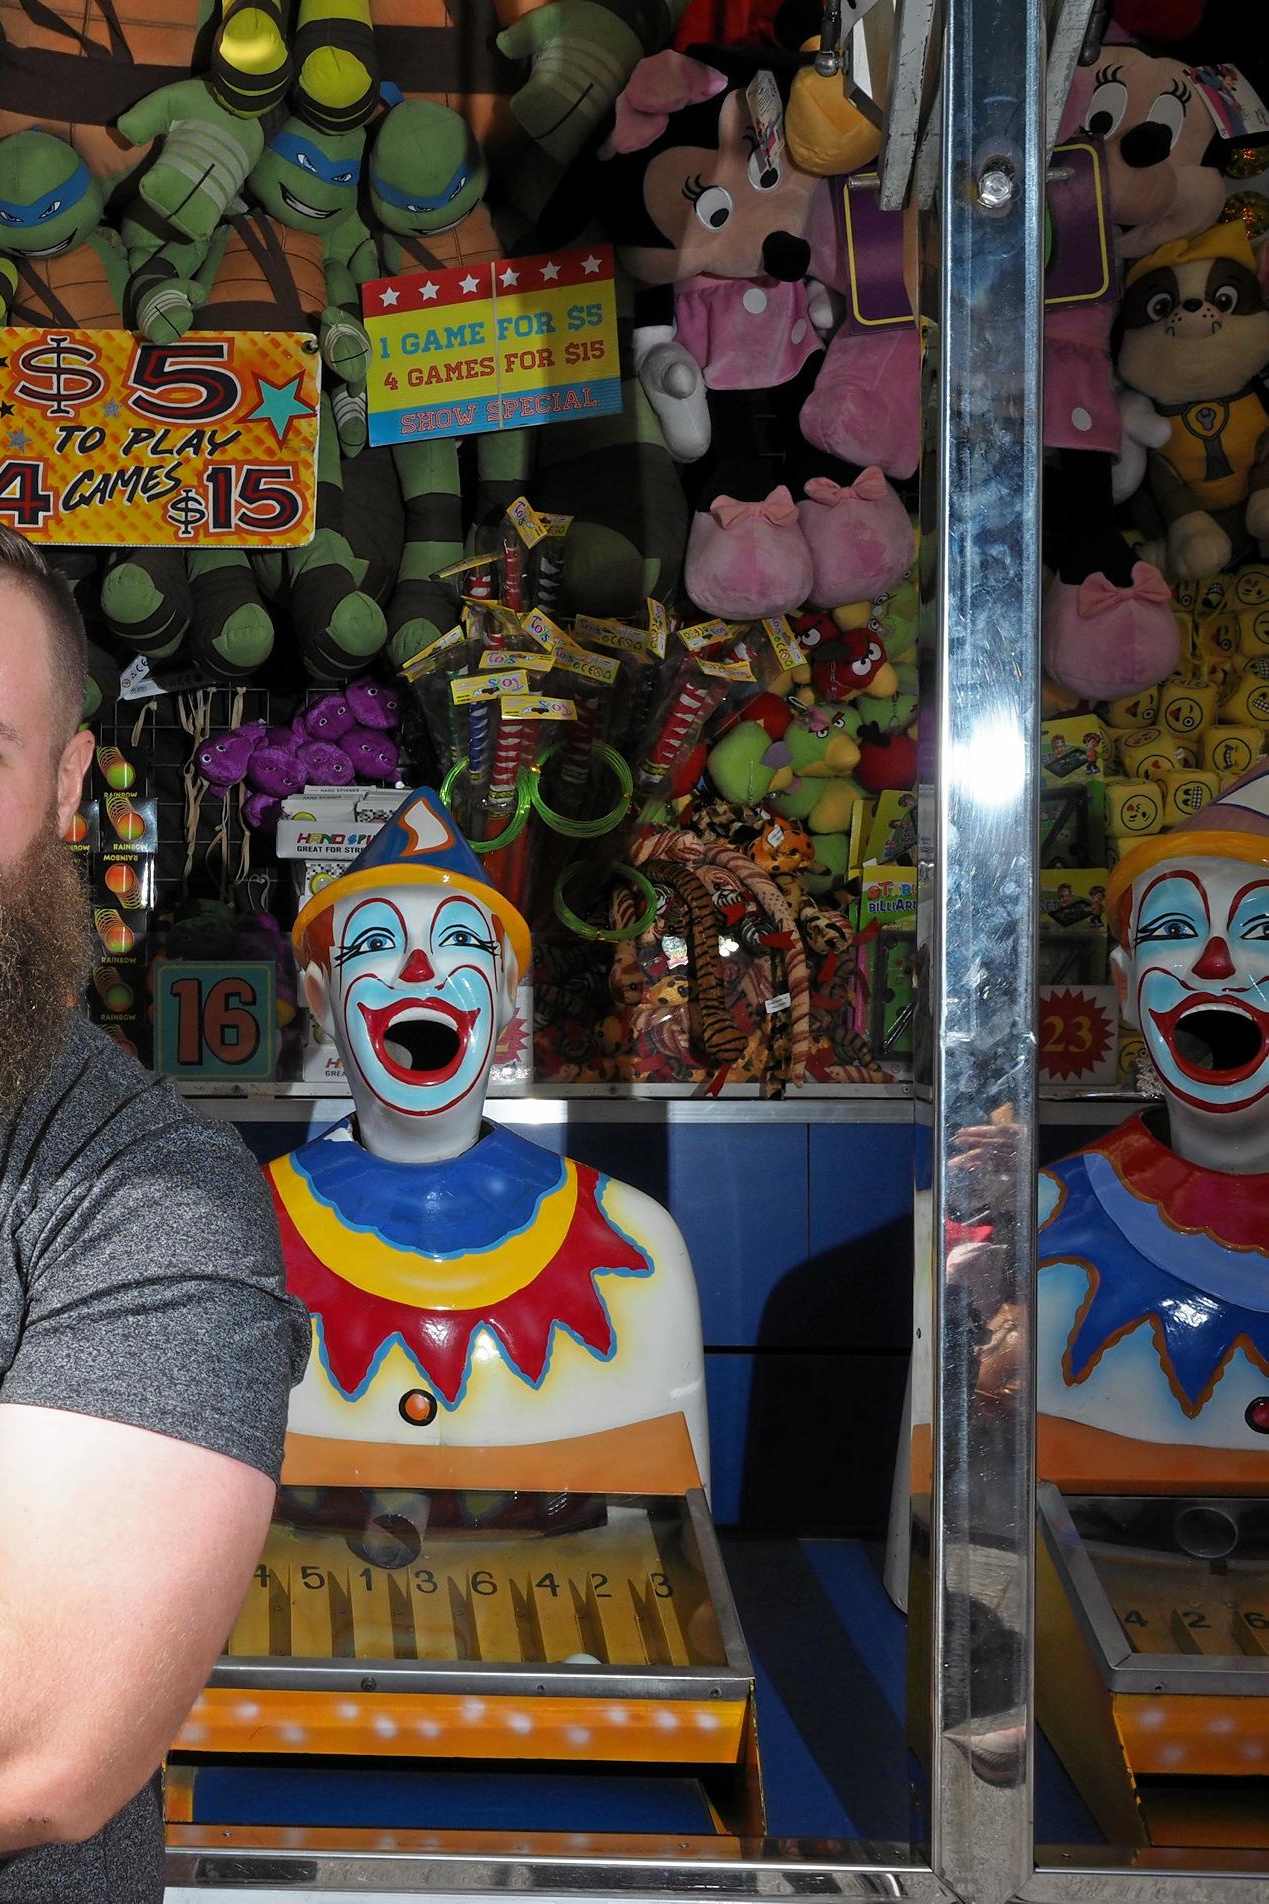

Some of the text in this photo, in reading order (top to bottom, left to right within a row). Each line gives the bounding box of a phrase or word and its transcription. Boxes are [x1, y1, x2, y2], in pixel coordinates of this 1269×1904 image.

[401, 321, 486, 356] GAME
[497, 311, 555, 341] FOR
[567, 304, 603, 332] $5
[383, 340, 605, 390] 4 GAMES FOR $15
[401, 387, 598, 434] SHOW SPECIAL
[54, 425, 243, 459] TO PLAY
[59, 461, 183, 514] GAMES
[167, 464, 303, 538] $15
[103, 854, 139, 862] RAINBOW
[297, 845, 323, 853] GREAT
[101, 956, 137, 964] RAINBOW
[170, 977, 261, 1066] 16
[1041, 1015, 1093, 1052] 23
[301, 1566, 325, 1590] 5
[359, 1568, 373, 1591] 1
[414, 1570, 439, 1594] 3
[470, 1571, 499, 1596] 6
[535, 1573, 560, 1598] 4
[591, 1574, 613, 1598] 2
[653, 1573, 674, 1598] 3
[1124, 1610, 1148, 1628] 4
[1182, 1611, 1213, 1628] 2
